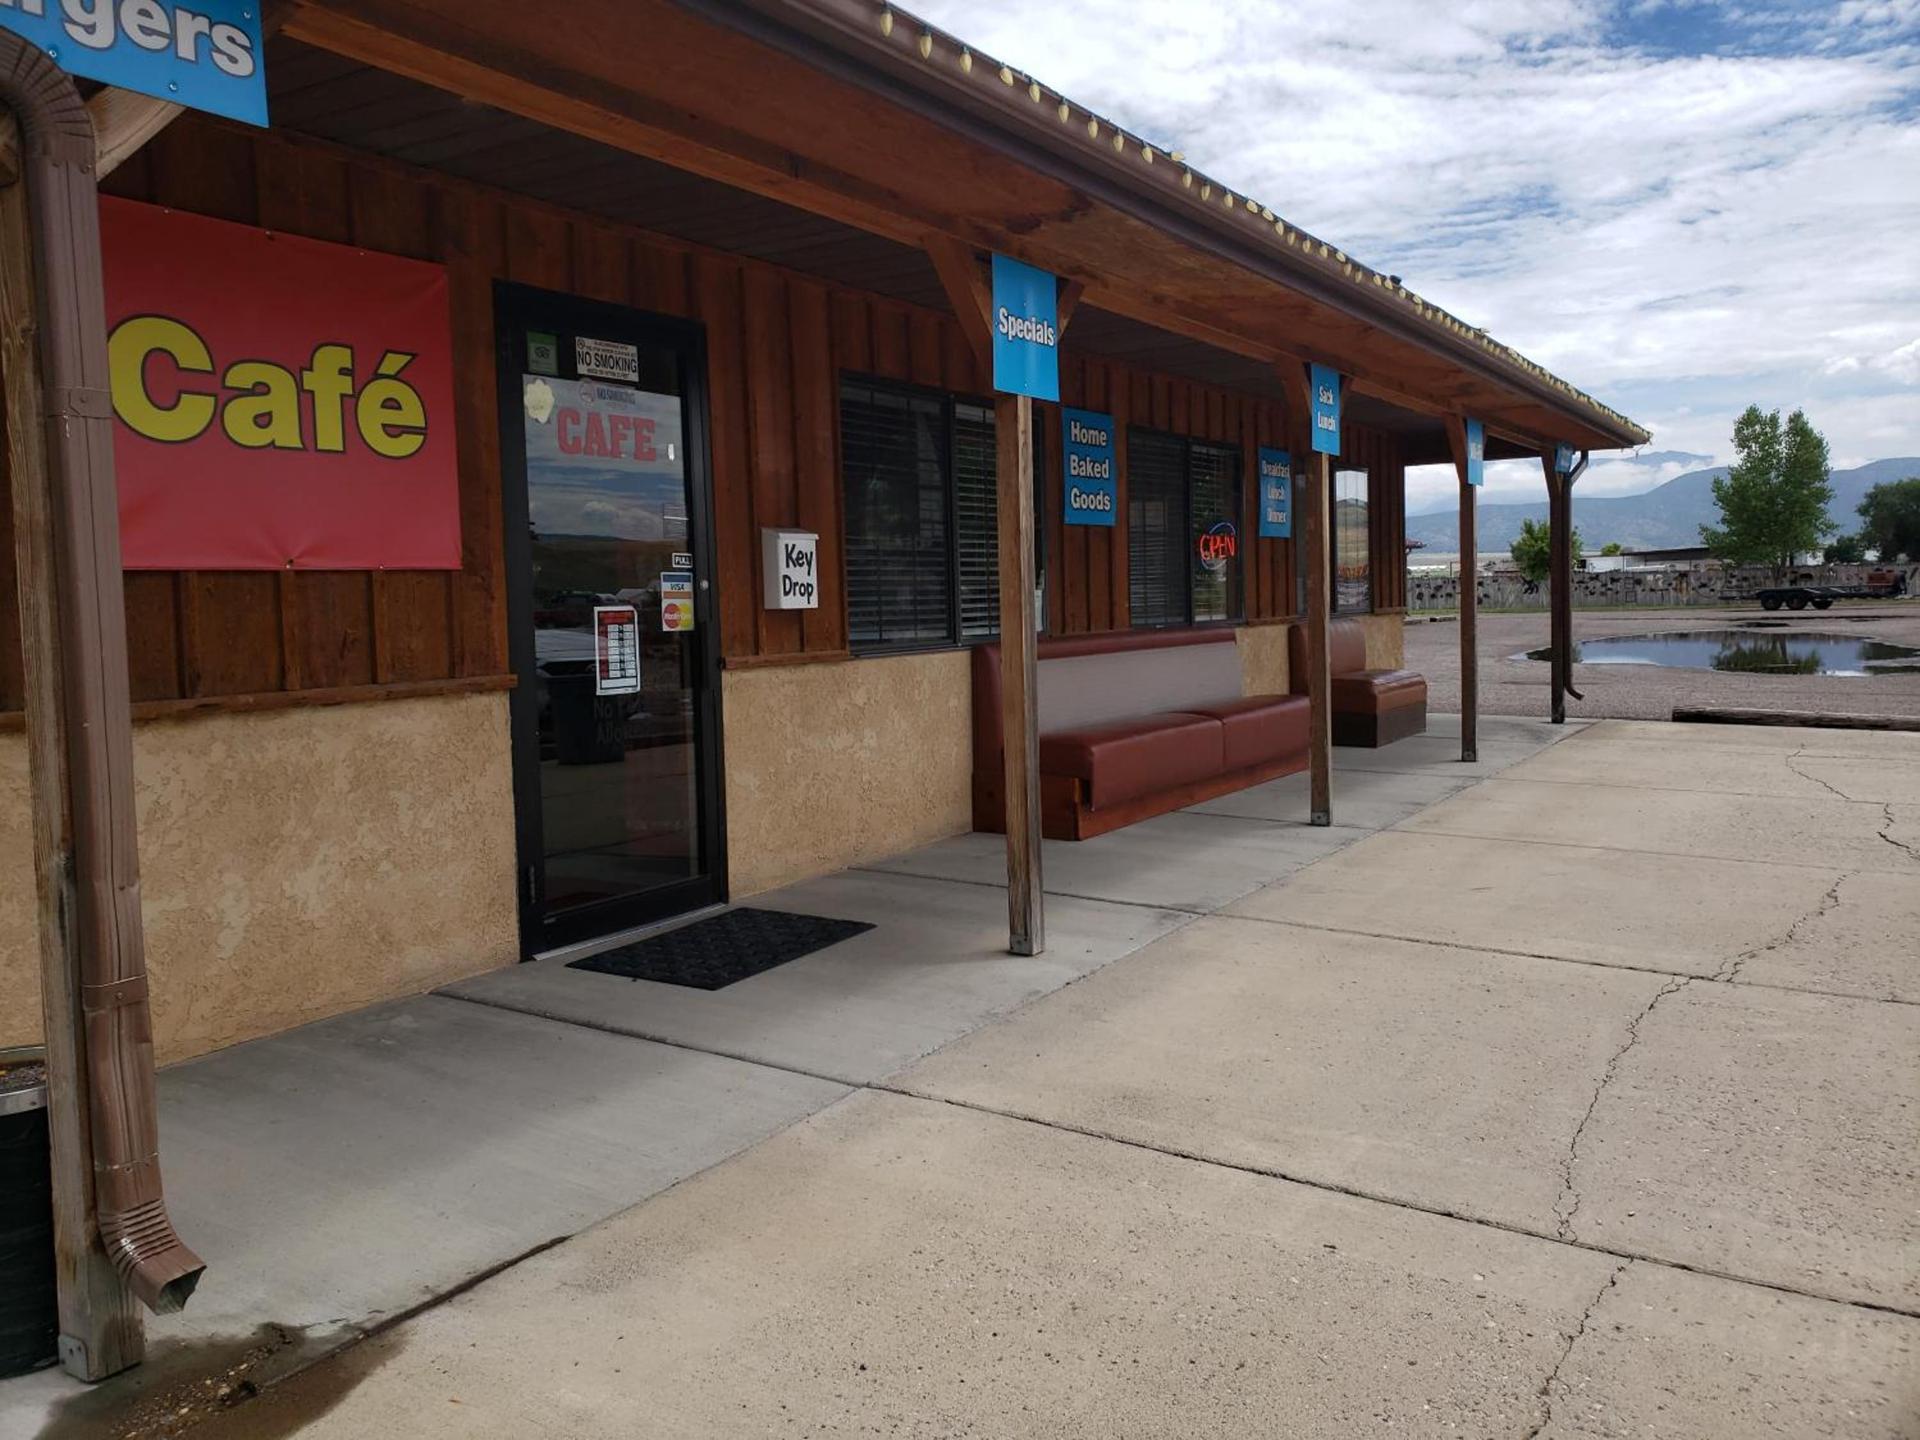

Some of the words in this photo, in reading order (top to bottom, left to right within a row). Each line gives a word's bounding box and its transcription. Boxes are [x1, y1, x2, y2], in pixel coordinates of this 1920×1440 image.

[0, 0, 255, 77] gers
[998, 306, 1055, 346] Specials
[577, 350, 592, 367] NO
[594, 353, 637, 373] SMOKING
[107, 313, 427, 460] Café
[557, 406, 656, 461] CAFE
[1070, 420, 1107, 447] Home
[1069, 454, 1110, 479] Baked
[1070, 488, 1111, 511] Goods
[1267, 484, 1285, 500] Lunch
[784, 544, 813, 576] Key
[1200, 534, 1235, 560] OPEN
[675, 556, 690, 565] PULL
[669, 583, 685, 591] VISA
[782, 574, 814, 604] Drop
